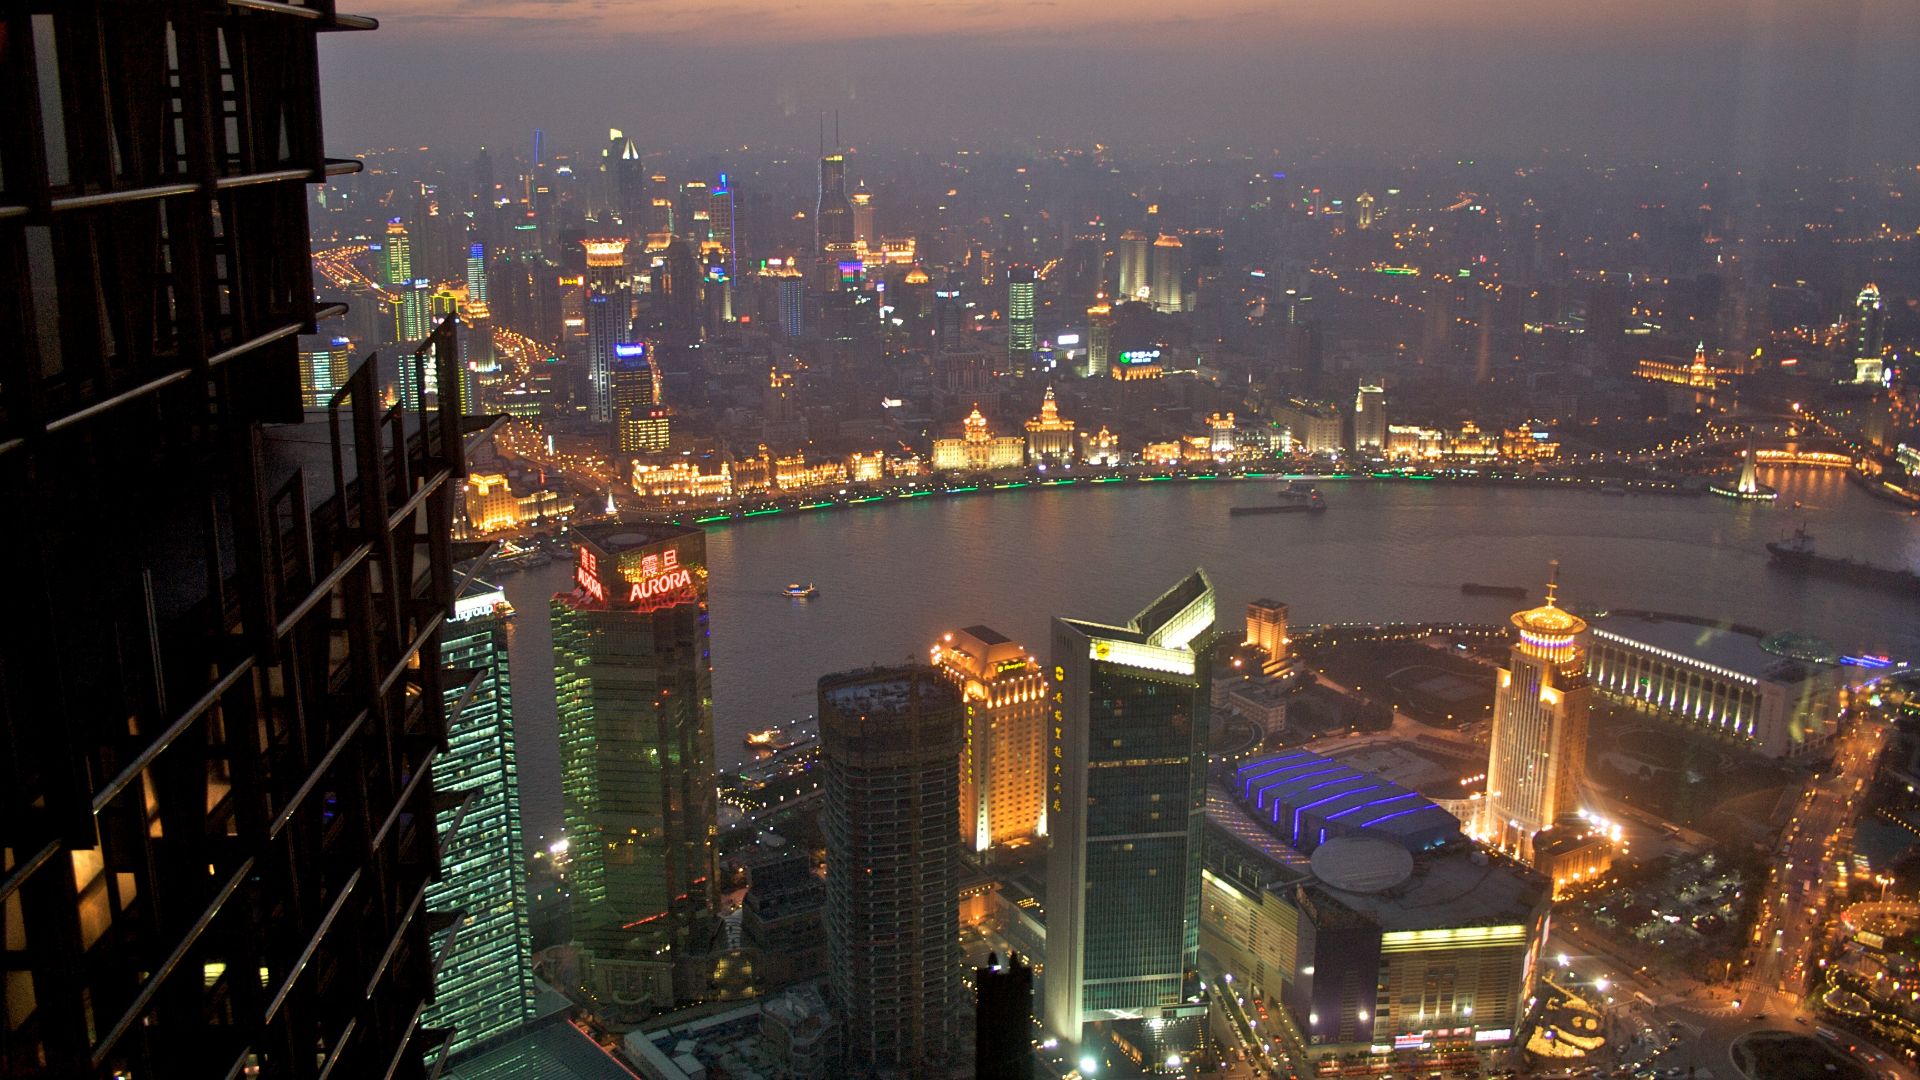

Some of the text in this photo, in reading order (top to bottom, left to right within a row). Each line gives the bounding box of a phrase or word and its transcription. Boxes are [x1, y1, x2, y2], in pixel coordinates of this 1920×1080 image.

[642, 549, 679, 577] 震旦
[578, 566, 603, 601] AURORA
[629, 569, 692, 602] AURORA
[446, 603, 494, 623] tigroup
